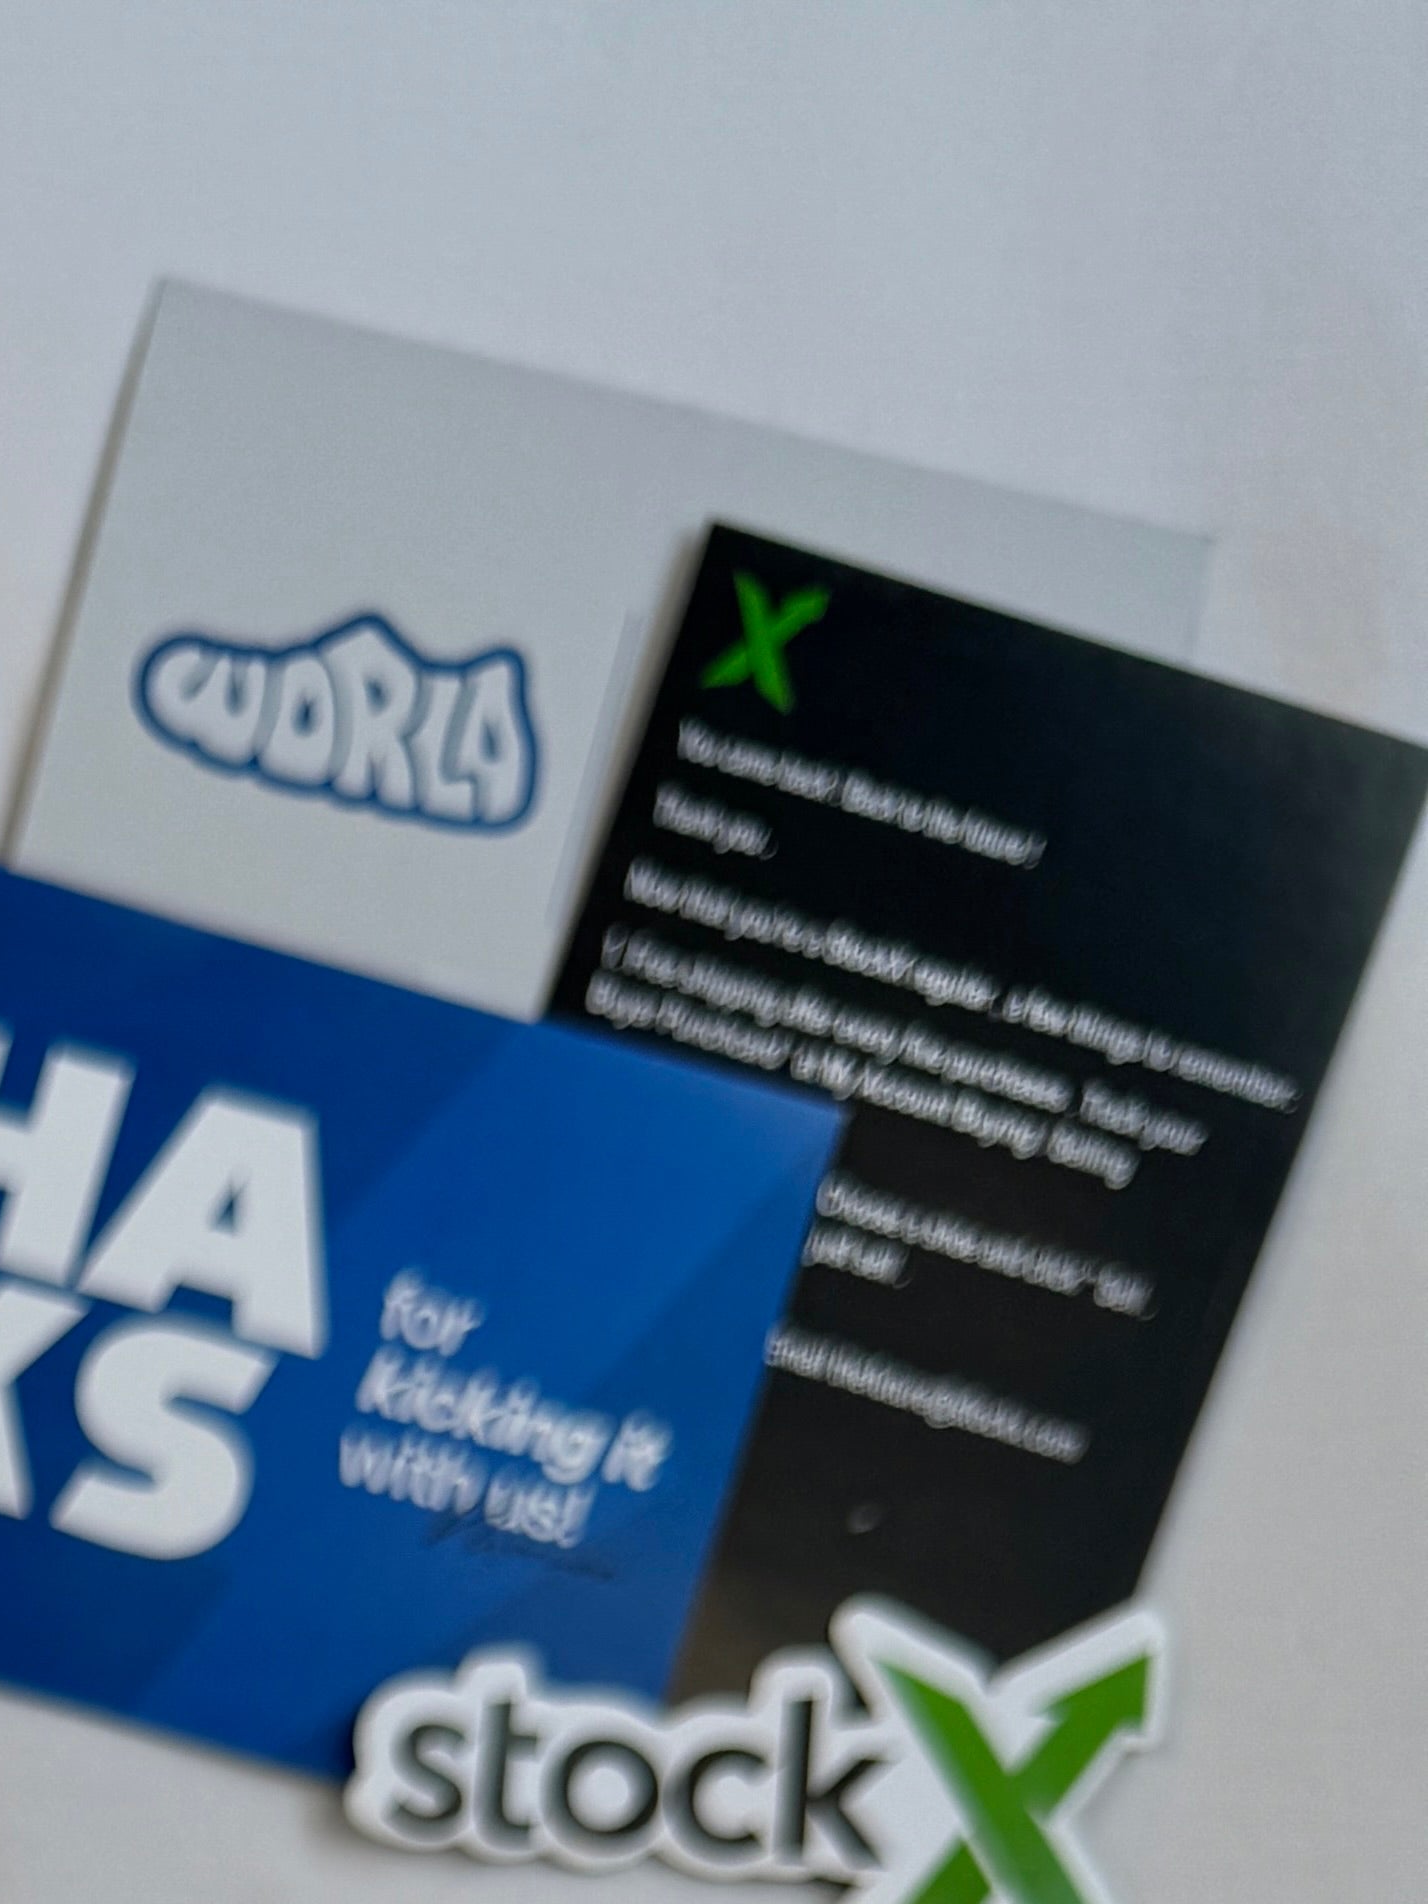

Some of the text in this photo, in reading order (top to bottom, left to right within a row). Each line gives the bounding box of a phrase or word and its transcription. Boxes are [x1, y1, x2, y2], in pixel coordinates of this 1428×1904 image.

[380, 1265, 486, 1356] for
[356, 1345, 672, 1491] kicking it
[339, 1427, 486, 1514] with
